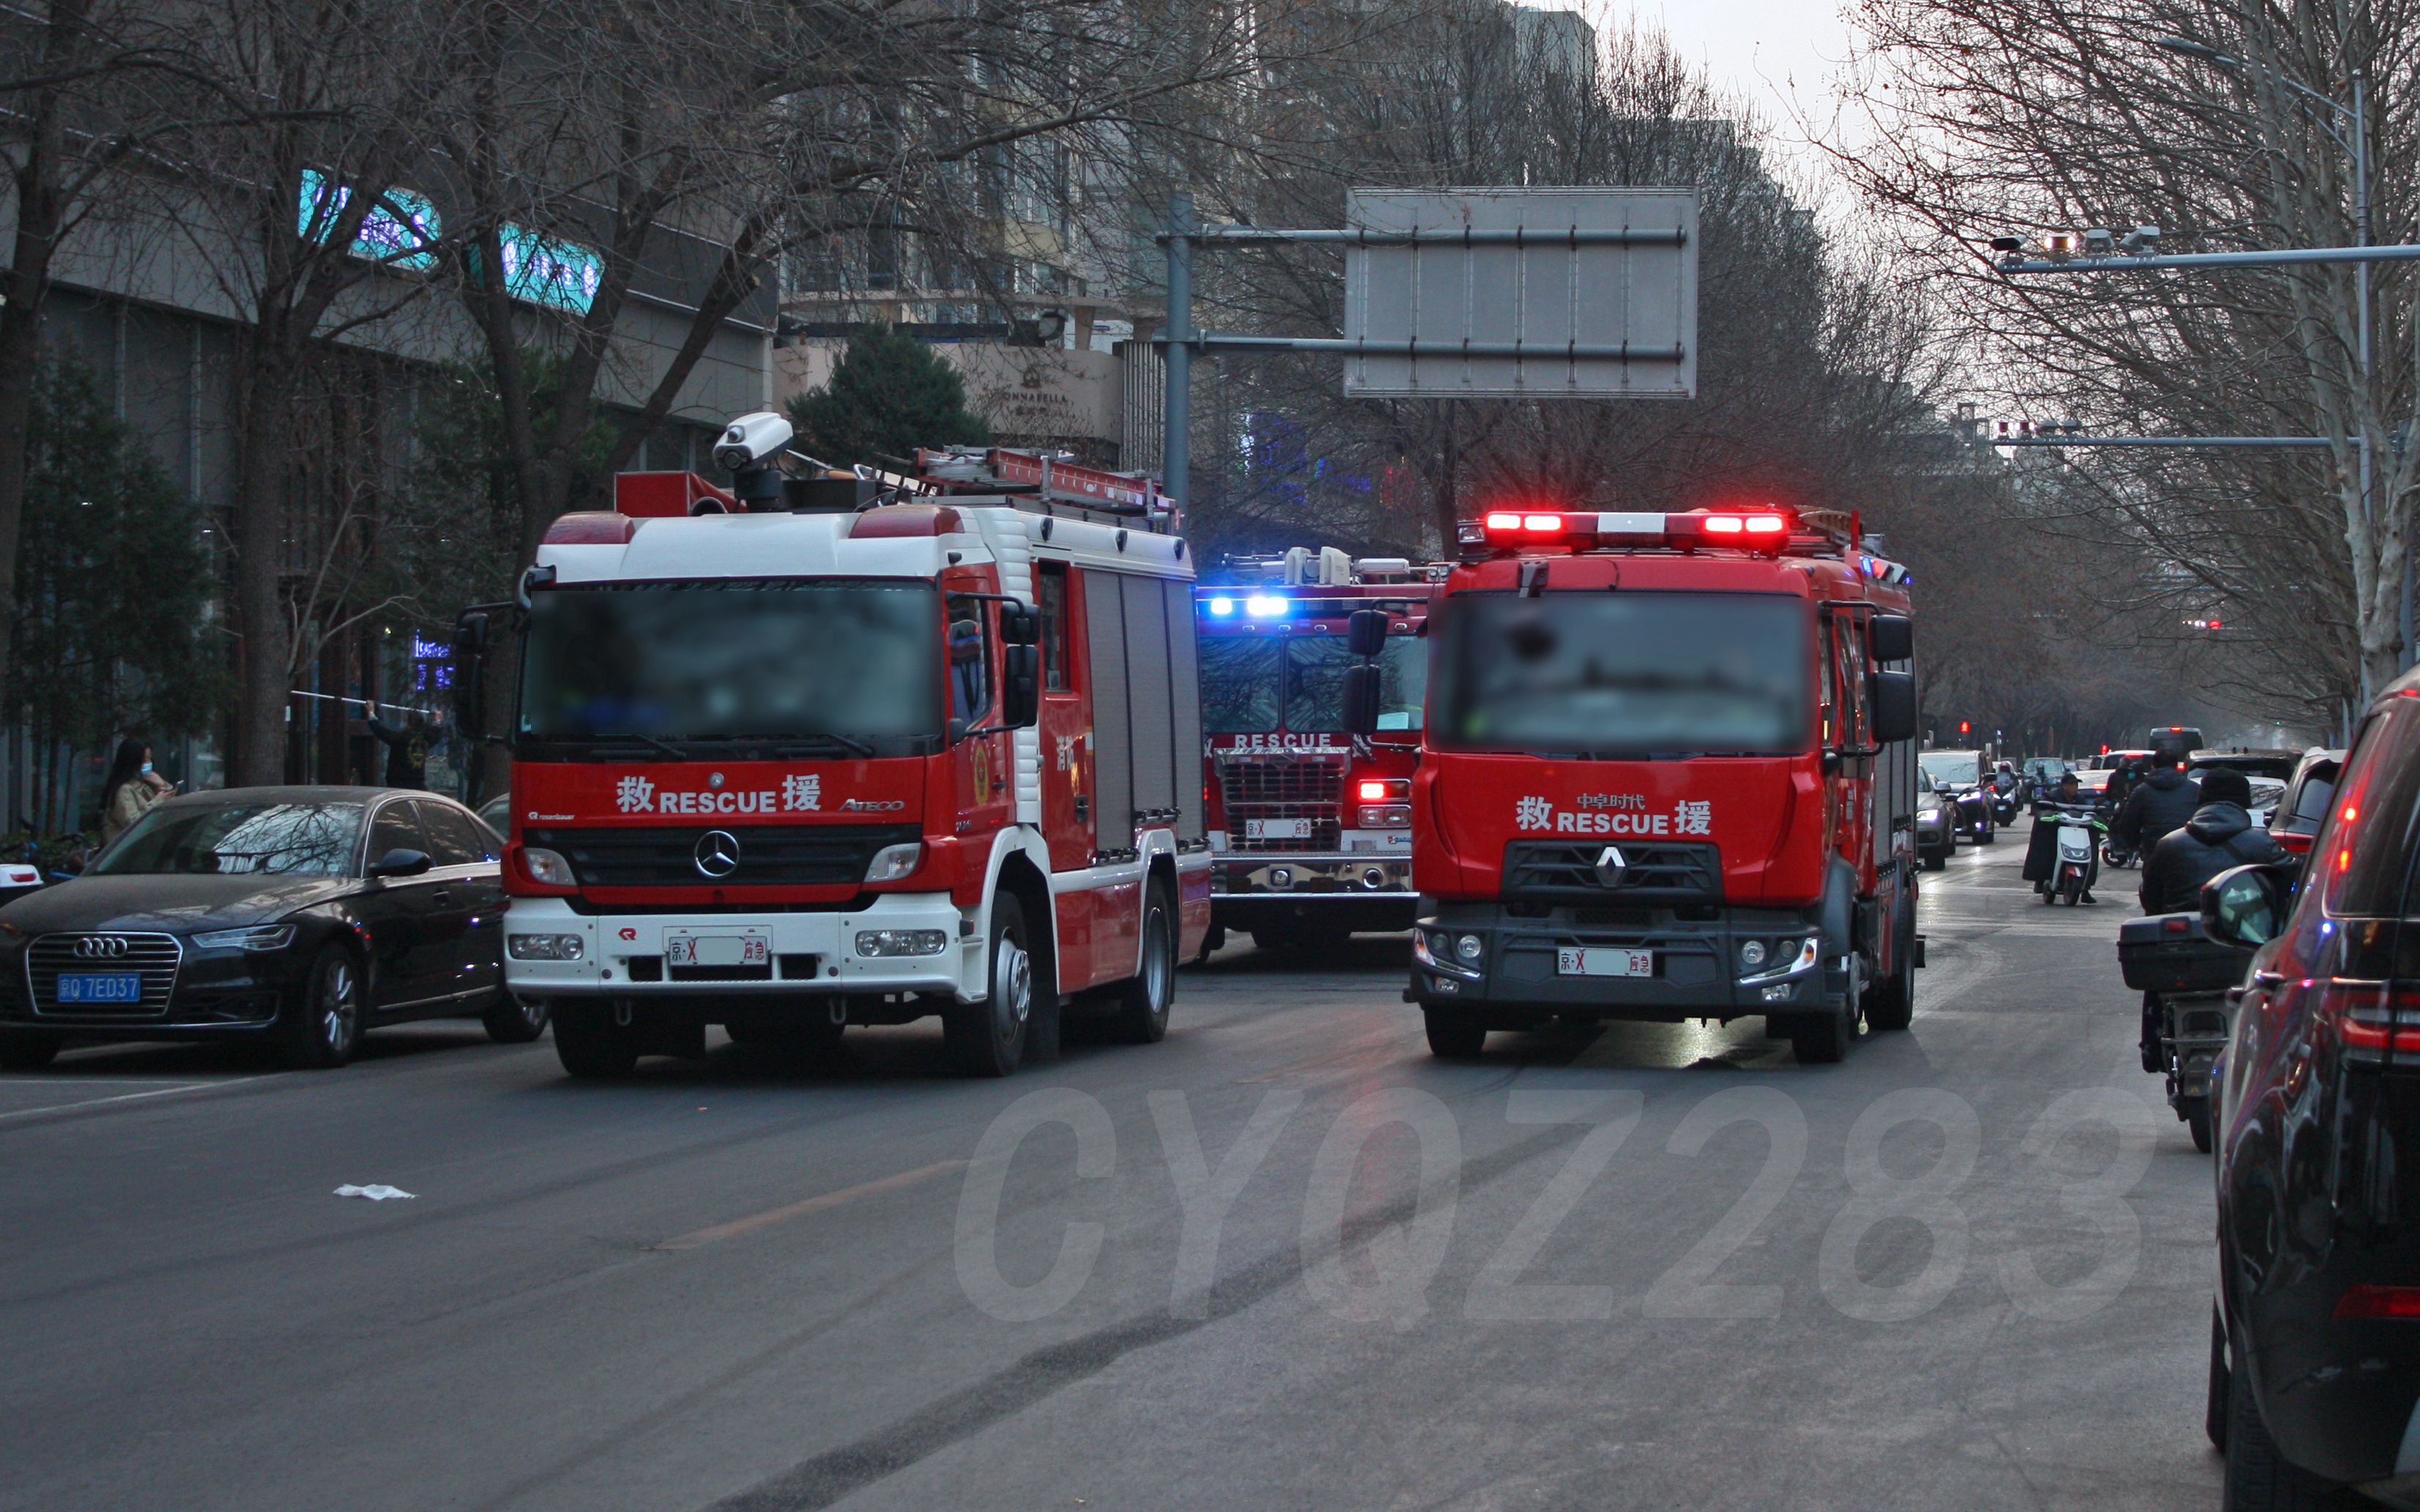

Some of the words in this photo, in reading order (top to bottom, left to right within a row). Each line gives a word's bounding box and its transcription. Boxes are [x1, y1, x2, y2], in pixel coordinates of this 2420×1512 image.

[1235, 734, 1331, 748] RESCUE
[617, 775, 655, 813] 救
[660, 792, 776, 813] RESCUE
[782, 774, 821, 811] 援
[1576, 793, 1646, 810] 中卓时代
[1515, 796, 1554, 830] 救
[1557, 812, 1669, 835] RESCUE
[1674, 800, 1712, 835] 援
